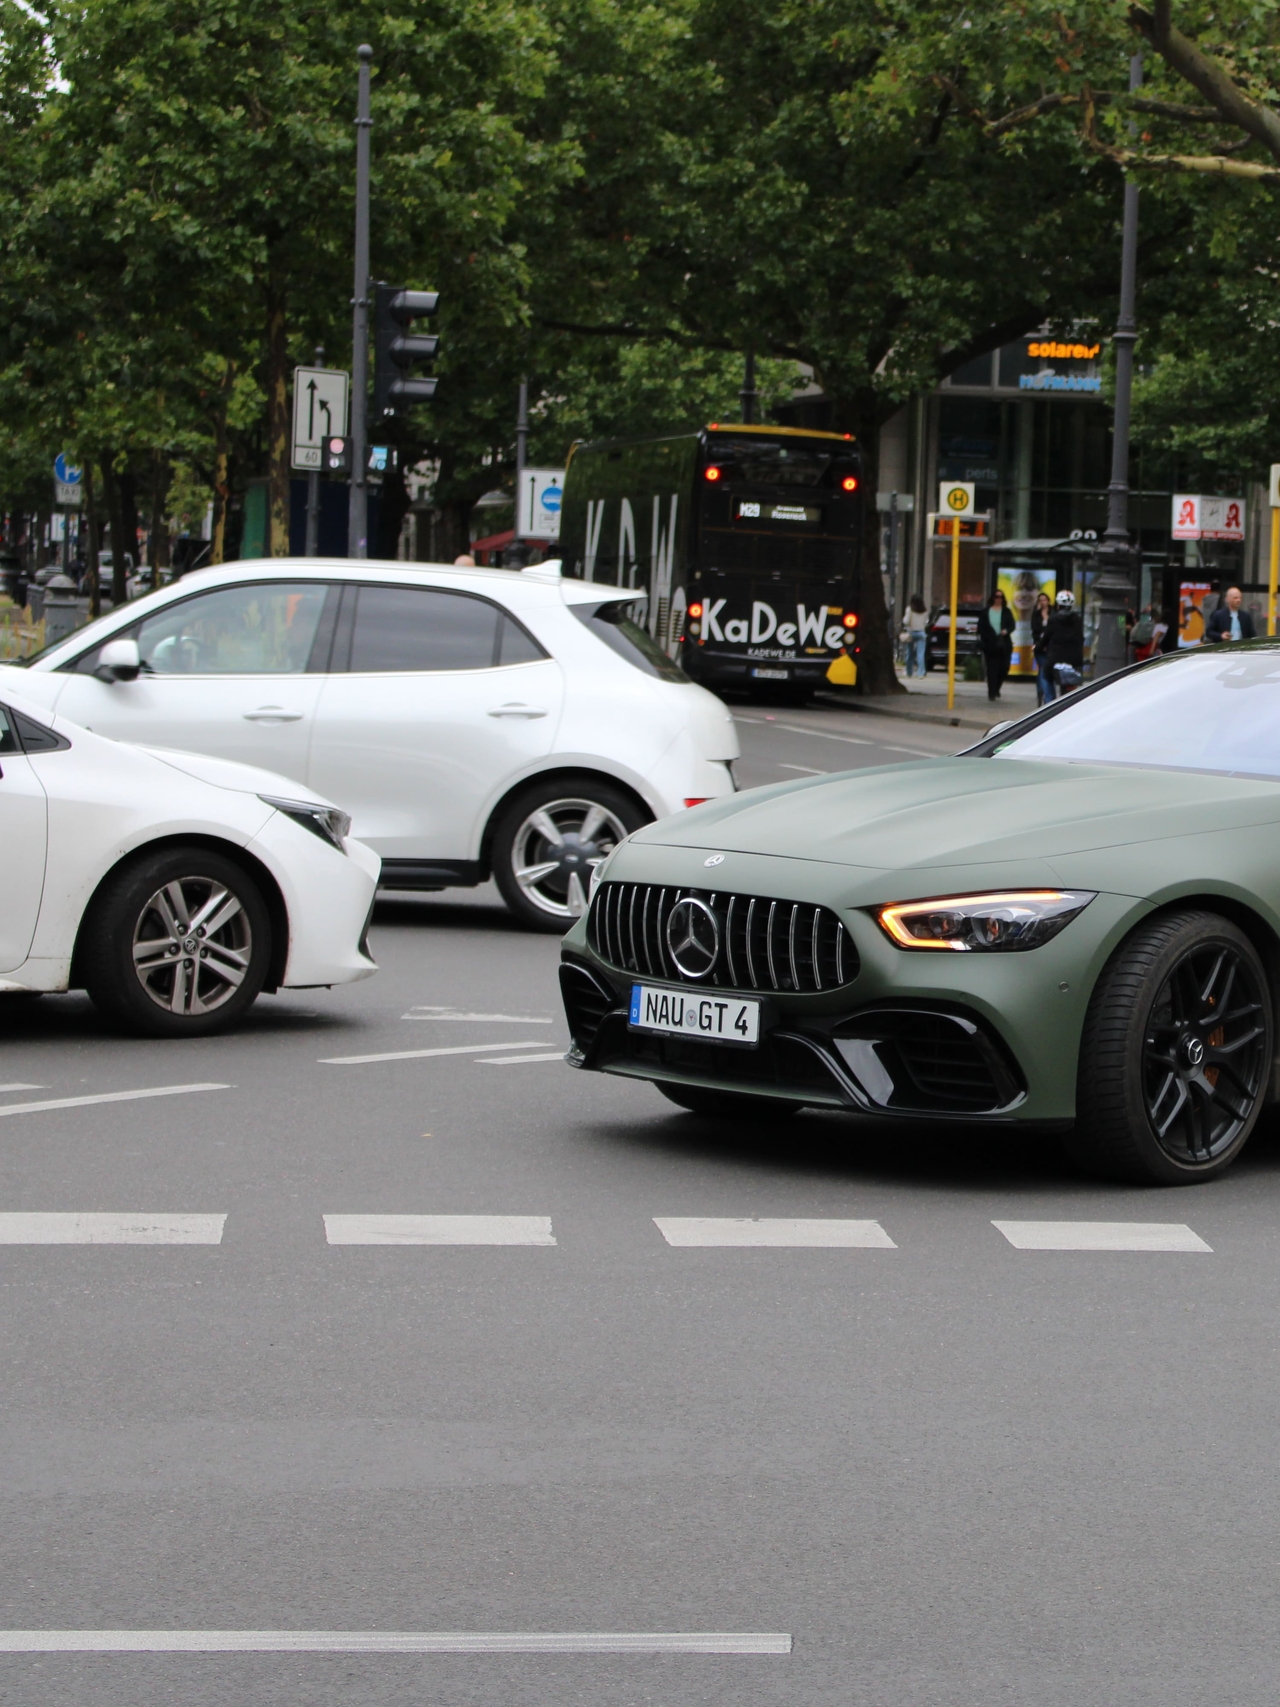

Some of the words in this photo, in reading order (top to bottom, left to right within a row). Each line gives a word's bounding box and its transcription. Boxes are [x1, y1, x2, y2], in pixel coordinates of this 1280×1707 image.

[739, 502, 760, 518] M29
[700, 597, 845, 649] KaDeWe
[748, 648, 796, 659] KADEWE.DE
[646, 993, 684, 1027] NAU
[699, 1000, 728, 1033] GT
[734, 1006, 748, 1036] 4
